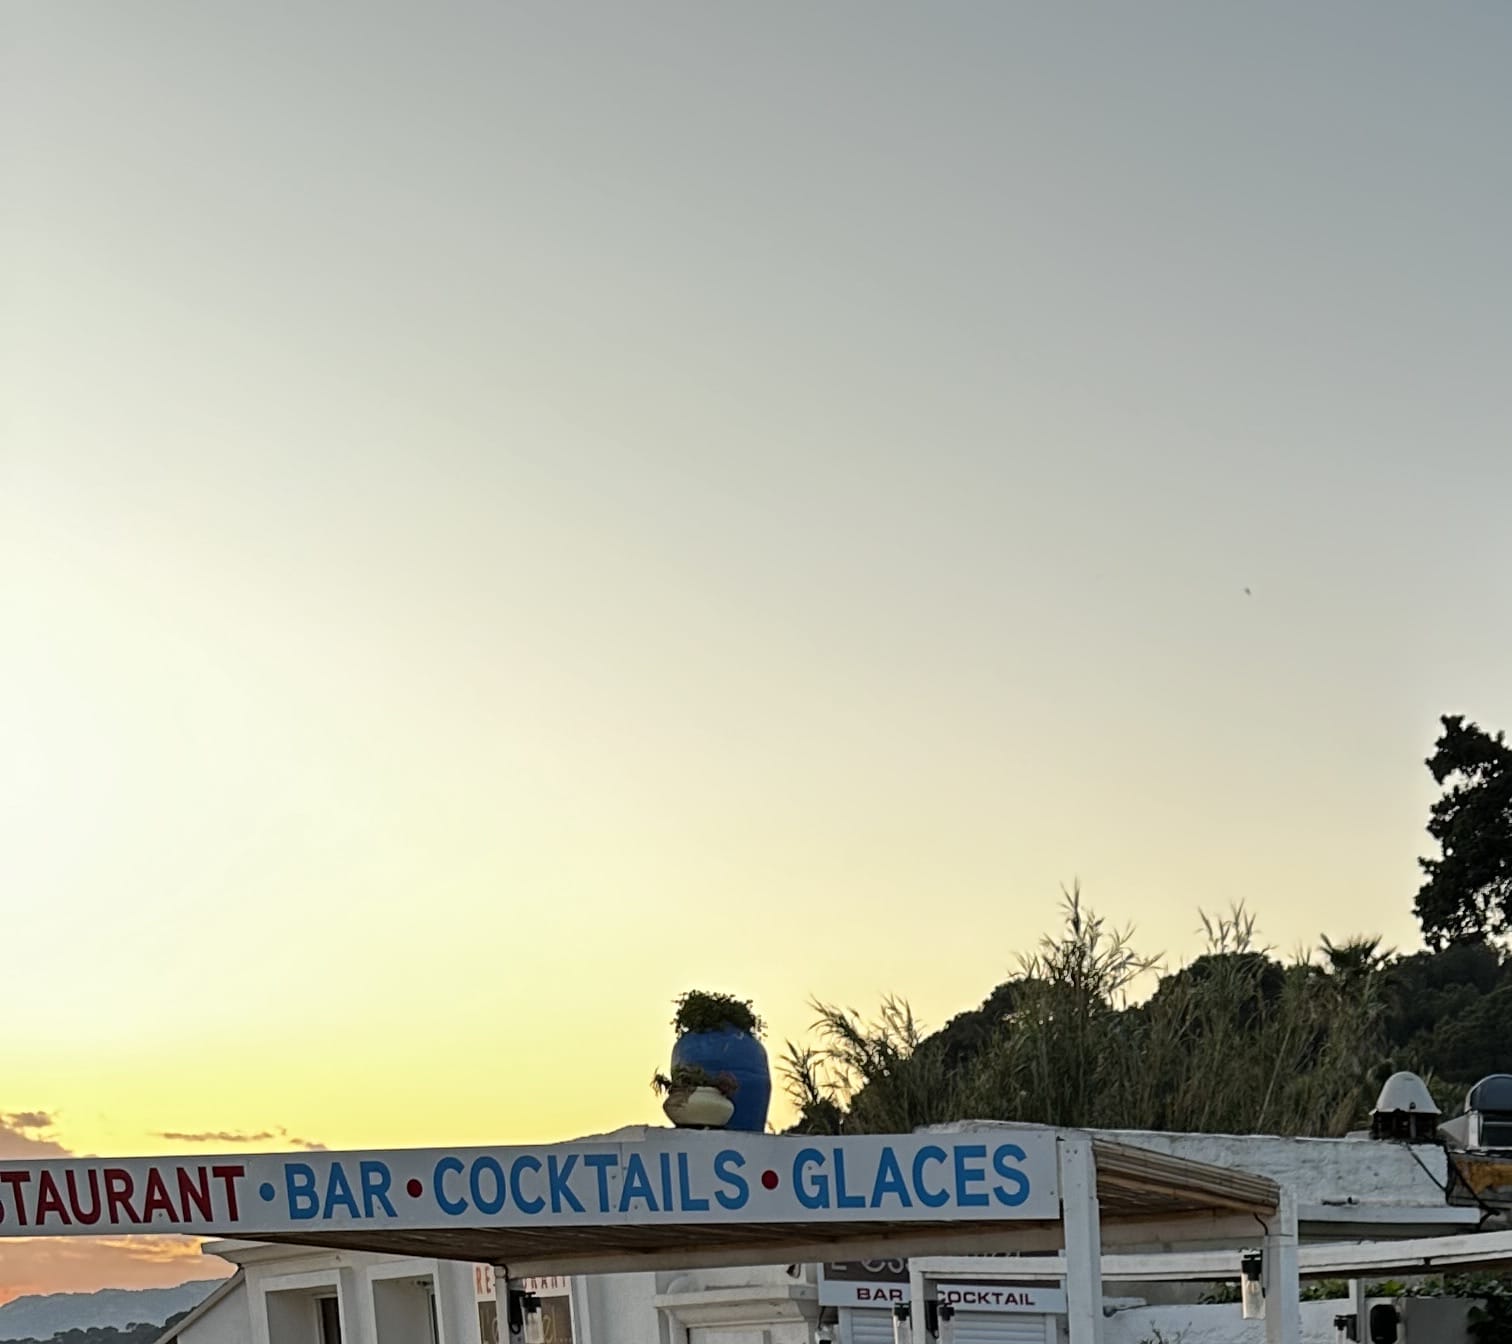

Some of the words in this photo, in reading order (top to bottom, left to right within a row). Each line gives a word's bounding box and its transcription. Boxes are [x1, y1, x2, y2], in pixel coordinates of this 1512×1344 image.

[0, 1165, 245, 1226] TAURANT
[285, 1161, 398, 1220] BAR
[433, 1150, 749, 1216] COCKTAILS
[792, 1144, 1030, 1209] GLACES
[857, 1287, 903, 1301] BAR
